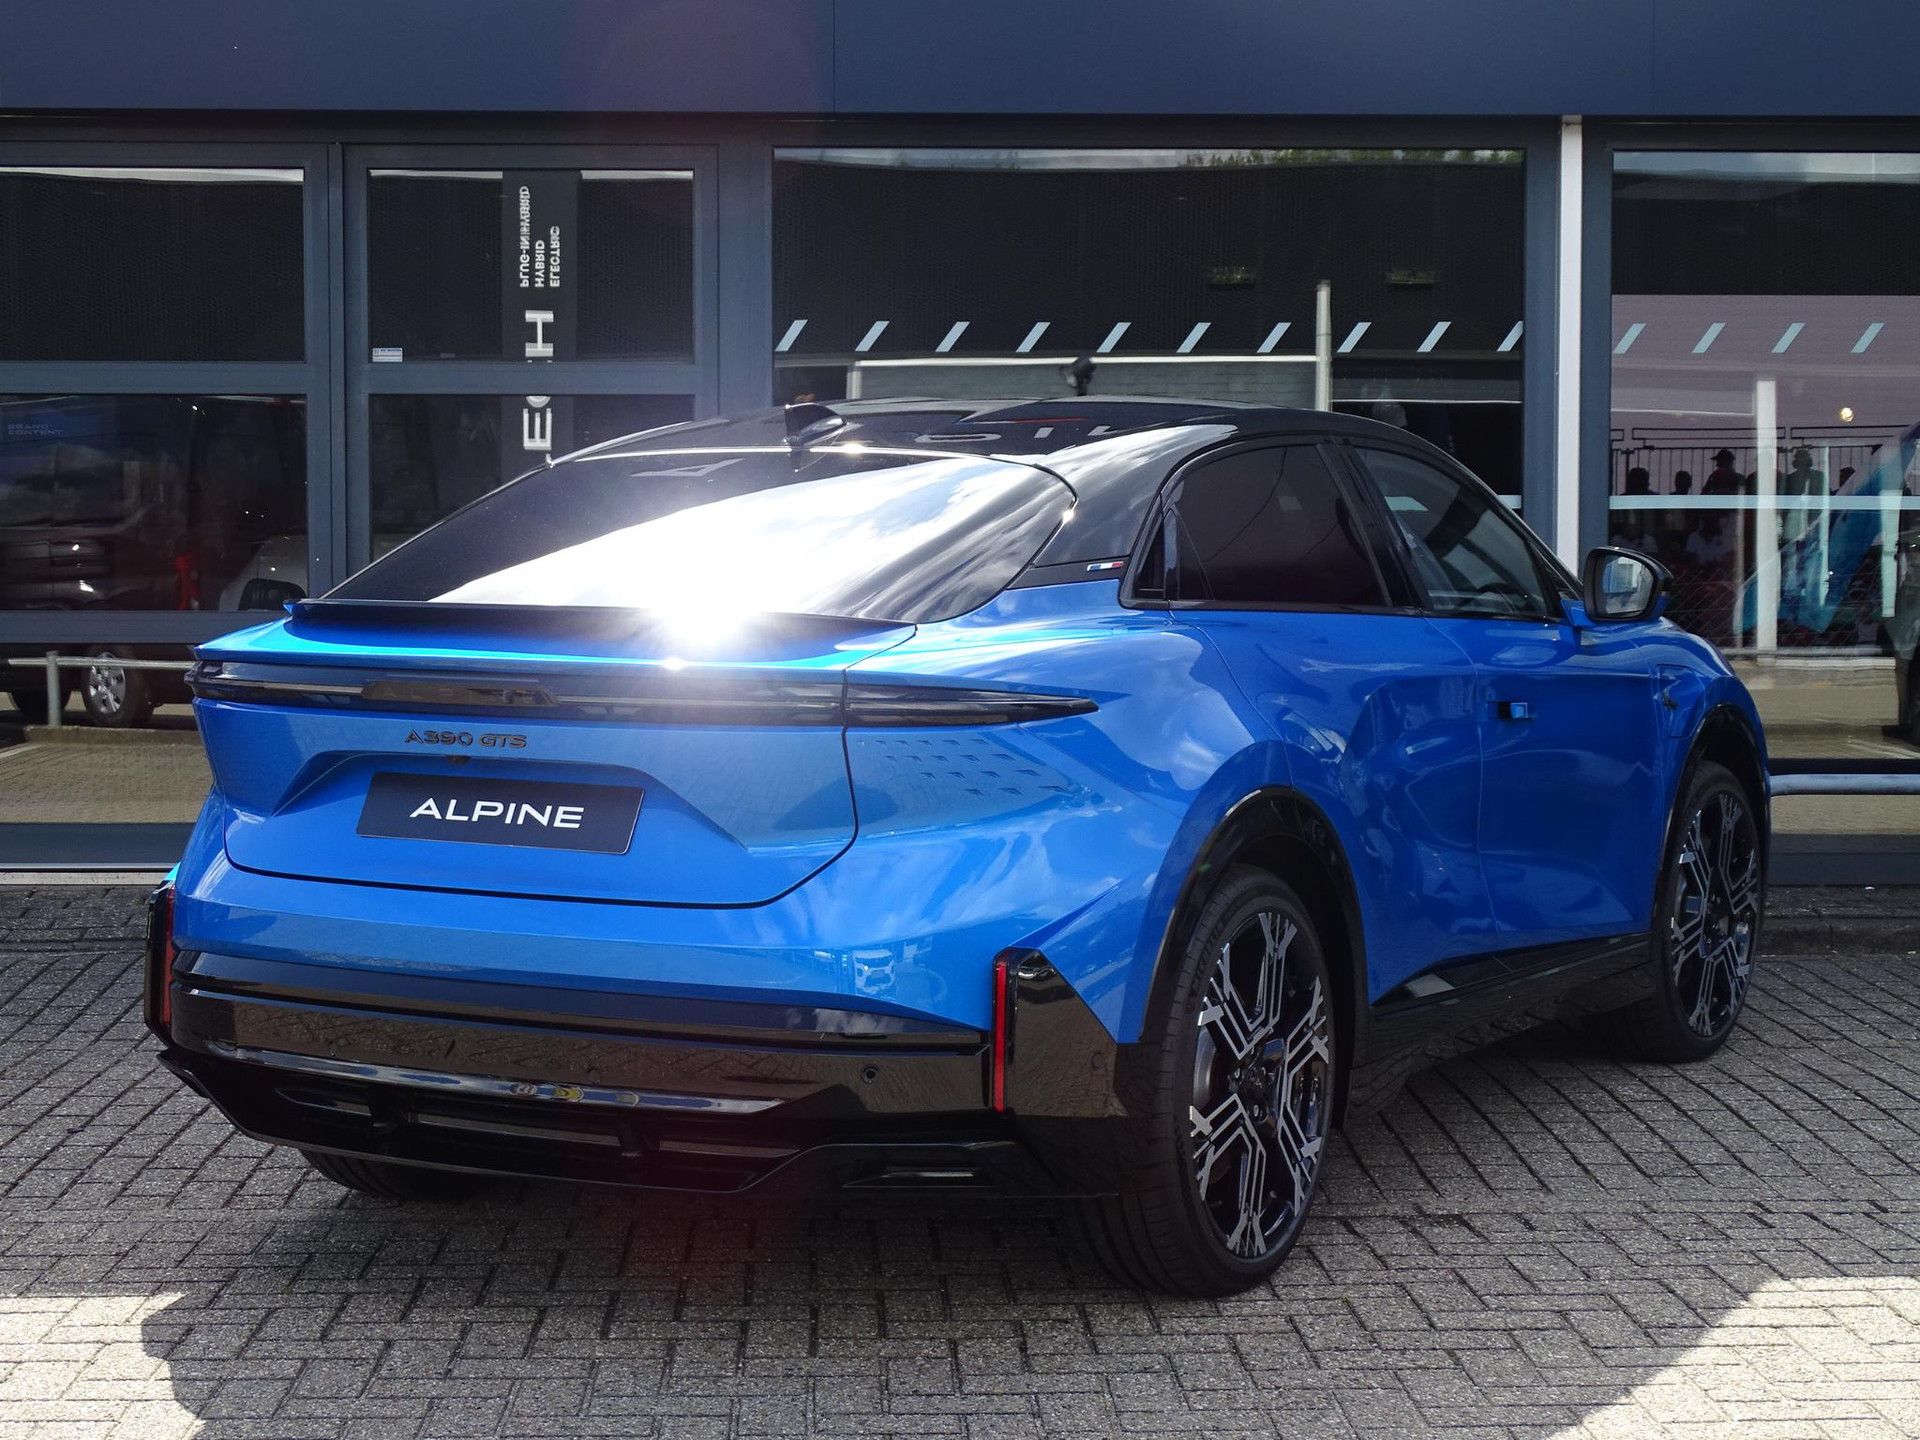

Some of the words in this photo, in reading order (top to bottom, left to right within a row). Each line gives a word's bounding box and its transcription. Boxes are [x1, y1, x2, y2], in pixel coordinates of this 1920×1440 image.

[405, 729, 474, 747] A390
[479, 733, 527, 749] GTS
[409, 797, 585, 829] ALPINE
